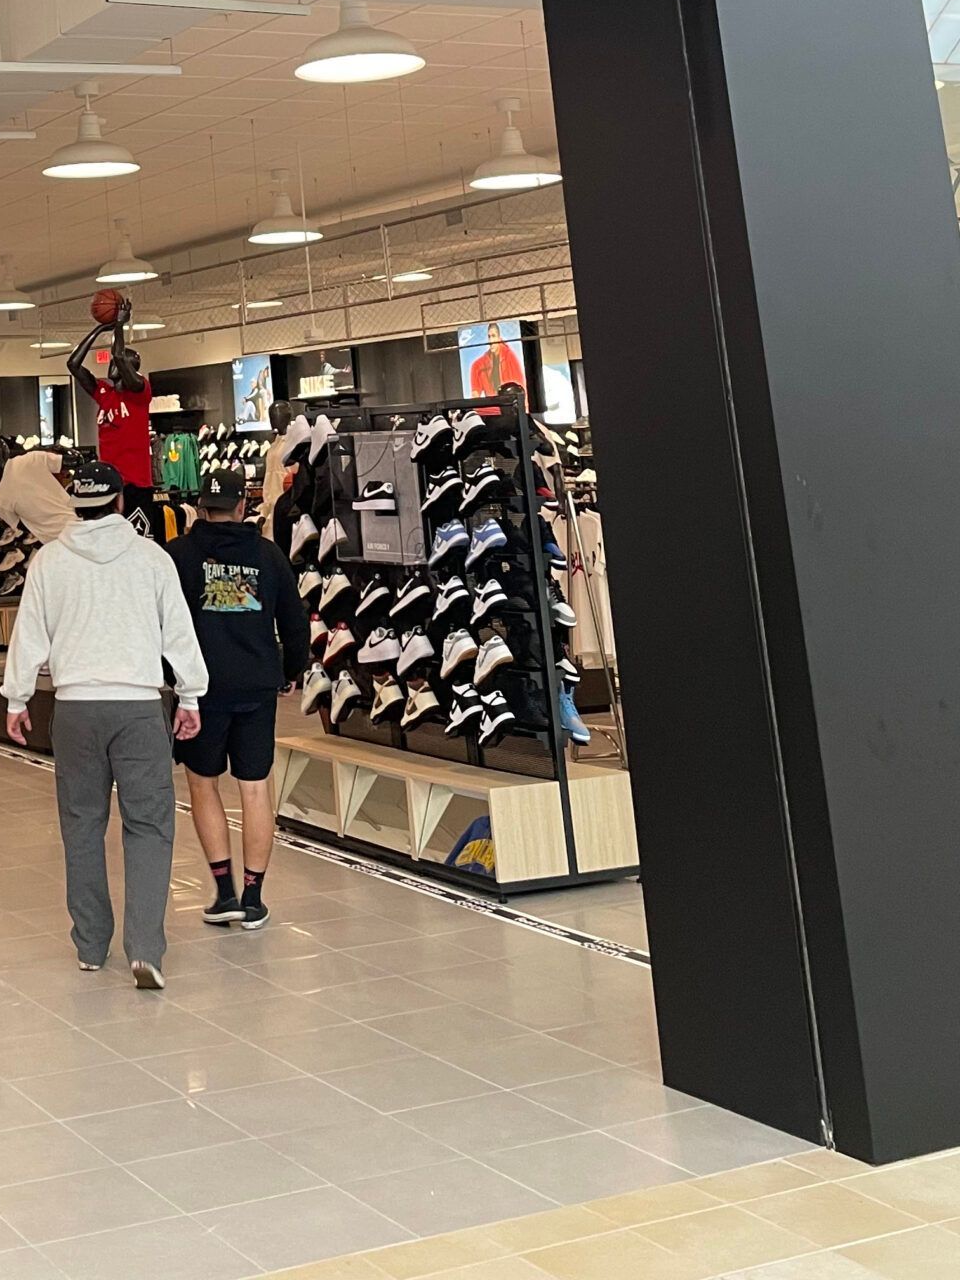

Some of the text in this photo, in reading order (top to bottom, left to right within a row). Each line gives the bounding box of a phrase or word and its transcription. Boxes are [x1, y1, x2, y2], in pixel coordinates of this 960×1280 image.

[300, 374, 334, 394] NIKE
[73, 480, 110, 493] Raiders
[202, 561, 226, 584] LEAVE
[242, 566, 260, 576] WET
